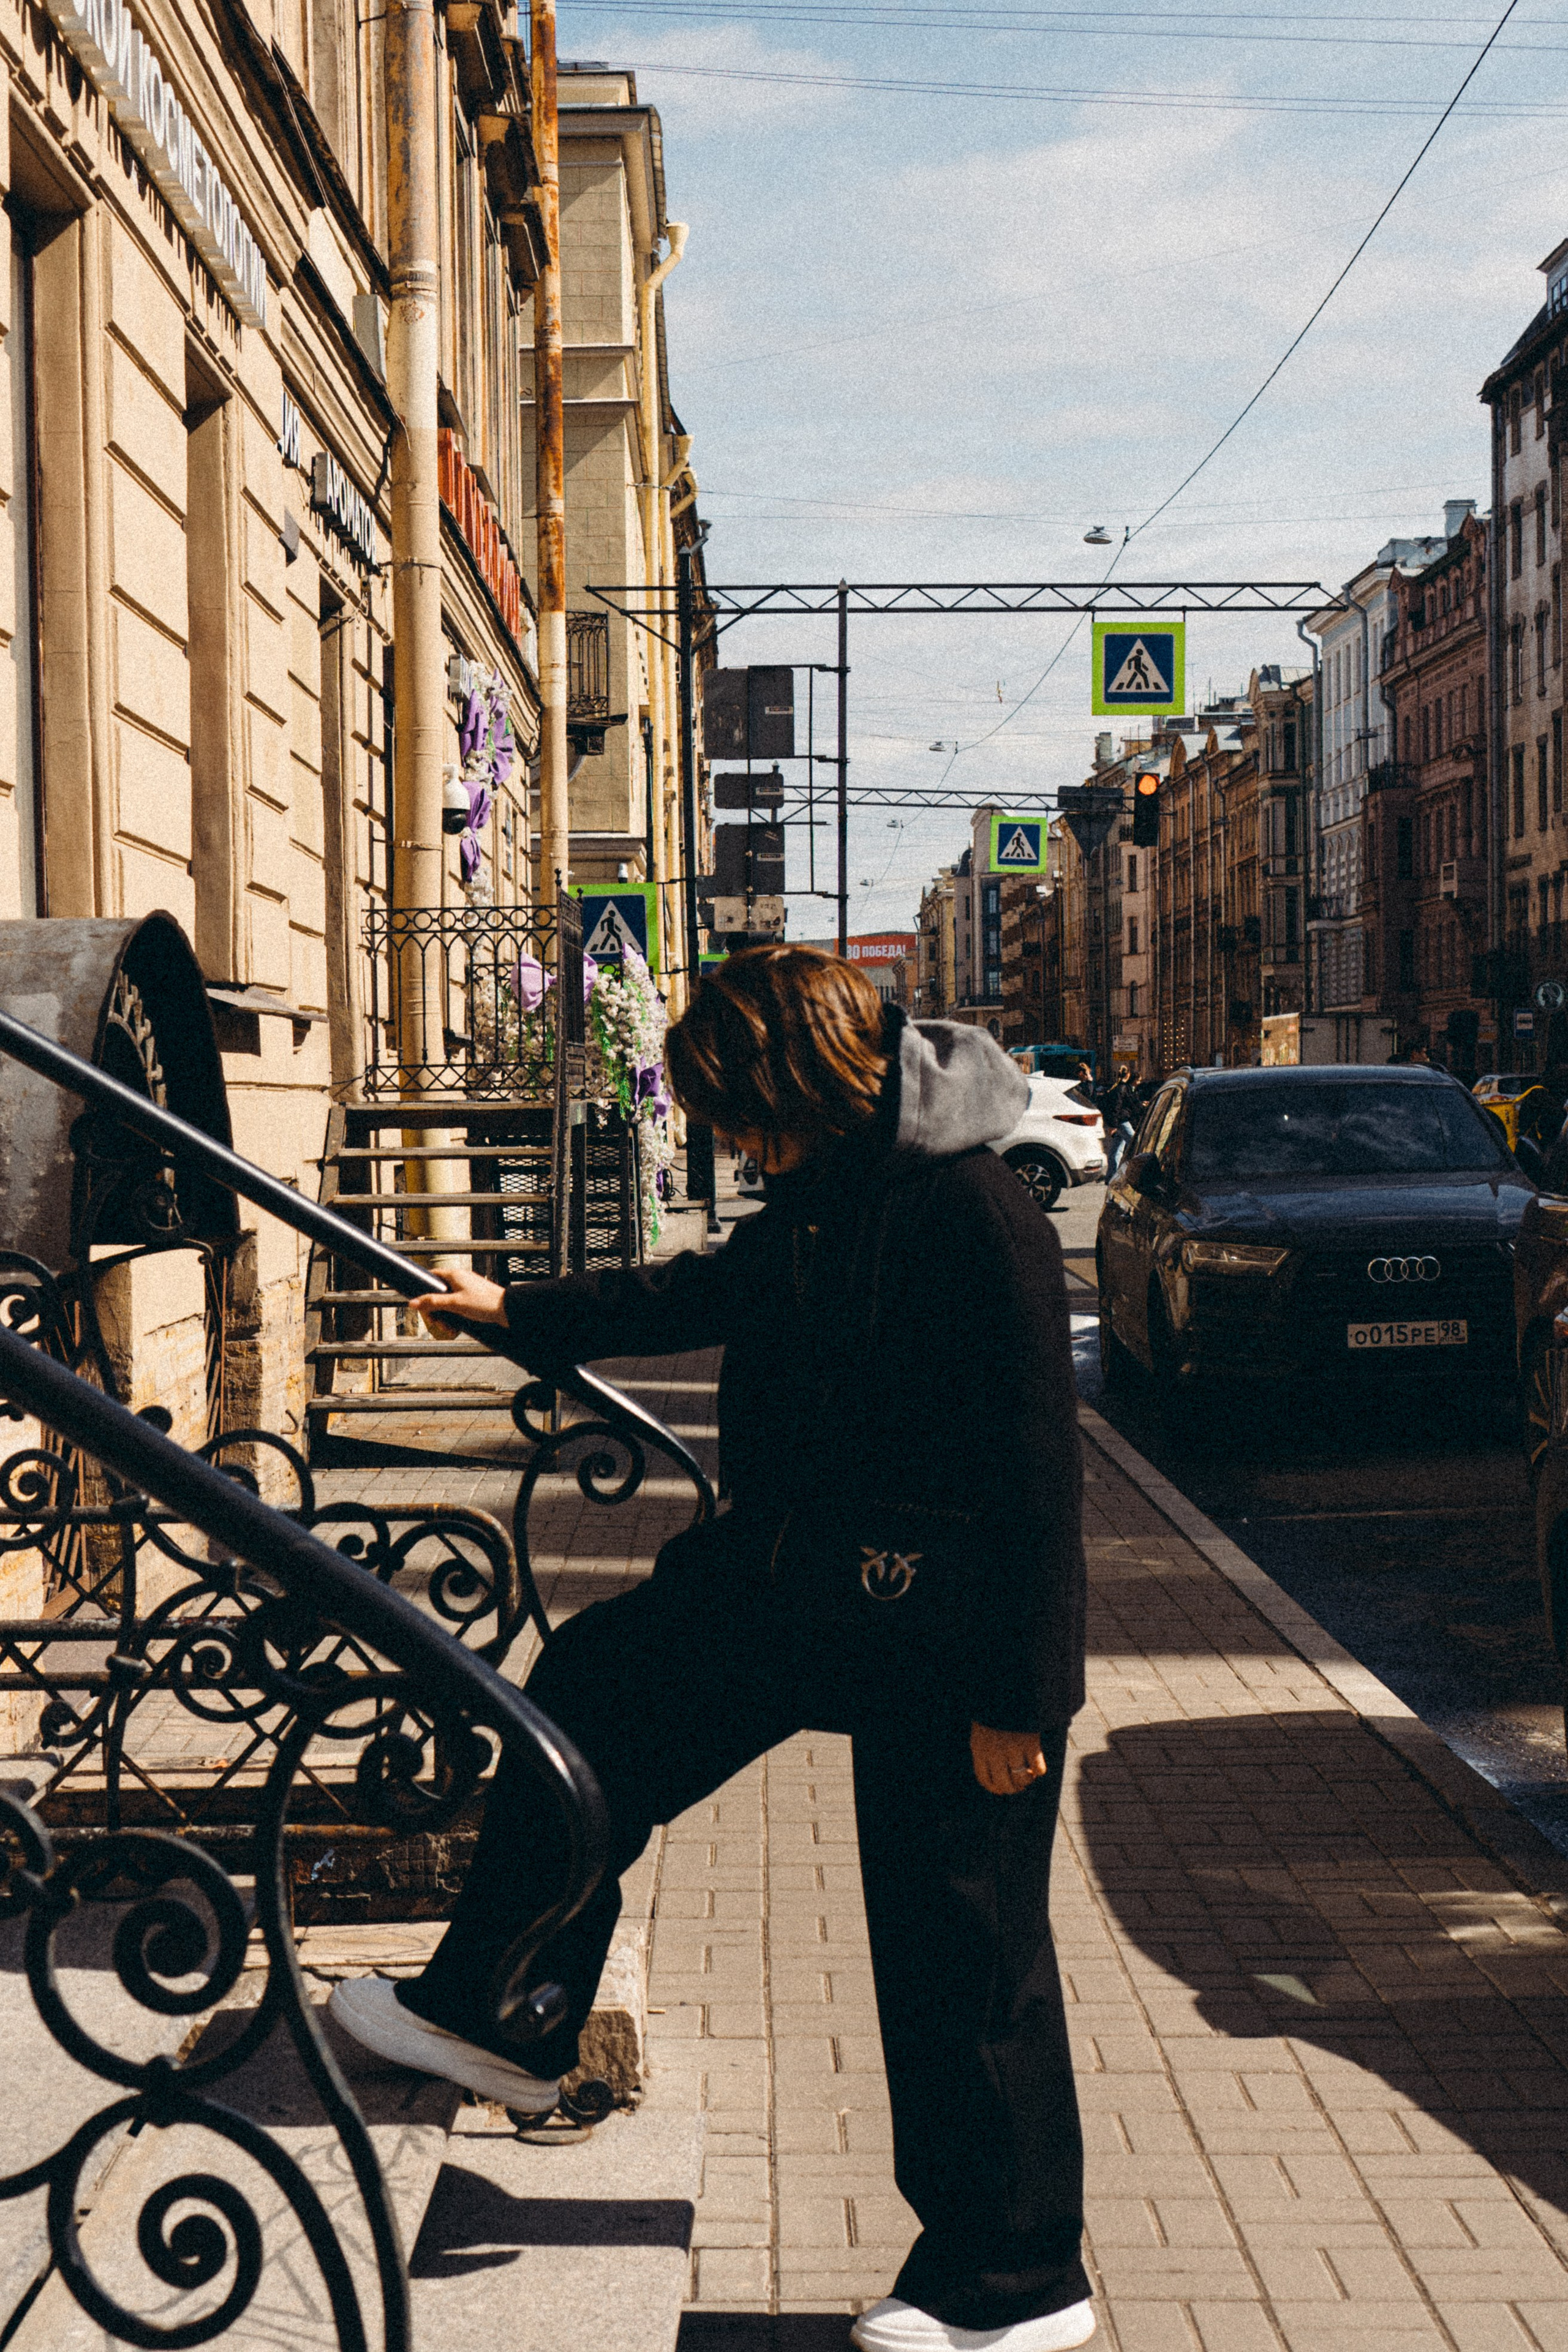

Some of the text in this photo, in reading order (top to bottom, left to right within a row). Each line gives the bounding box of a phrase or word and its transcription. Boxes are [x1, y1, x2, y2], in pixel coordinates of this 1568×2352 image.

[140, 30, 266, 328] КОСМЕТОЛОГИИ
[326, 451, 379, 567] АРОМАТОВ
[862, 945, 905, 958] ПОБЕДА!
[1355, 1322, 1460, 1344] О015РЕ 98
